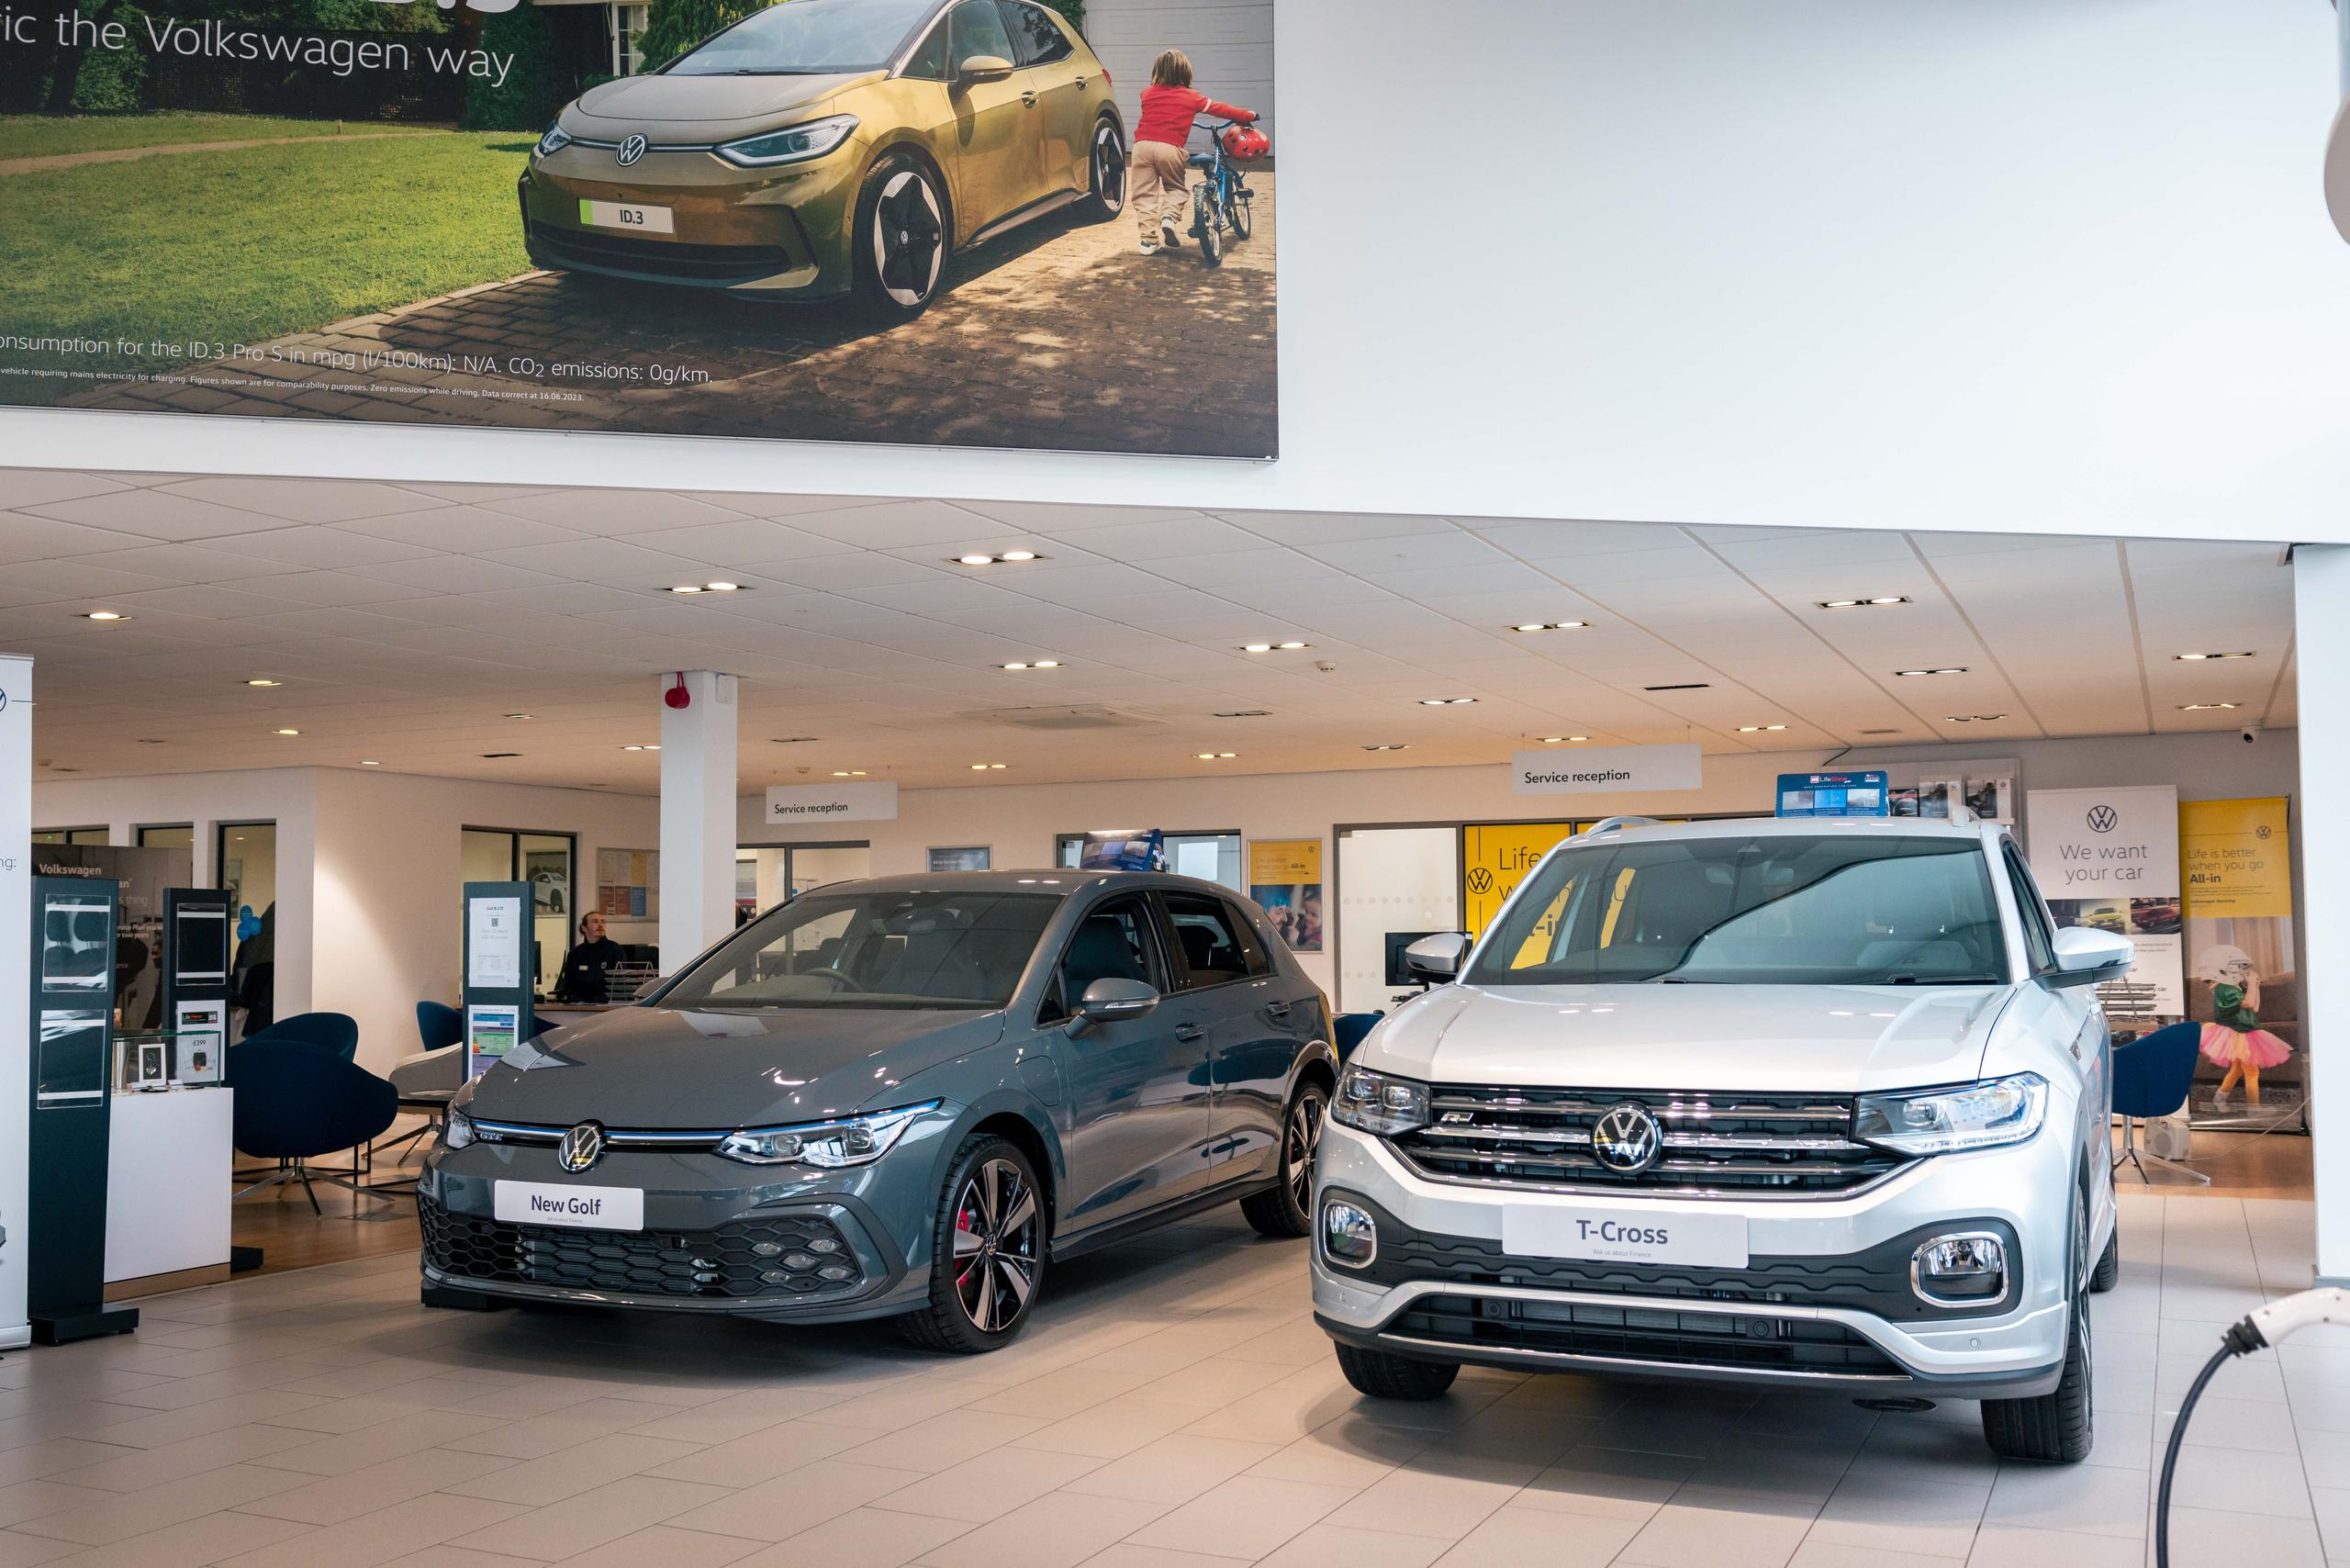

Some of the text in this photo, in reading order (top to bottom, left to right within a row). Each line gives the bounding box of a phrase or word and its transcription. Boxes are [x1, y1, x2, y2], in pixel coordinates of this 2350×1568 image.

[0, 6, 515, 88] ic the Volkswagen way
[620, 209, 643, 225] ID.3
[118, 338, 143, 356] for
[151, 340, 182, 357] the
[189, 342, 225, 359] ID.3
[233, 343, 264, 362] Pro
[272, 345, 283, 363] S
[290, 347, 305, 364] in
[313, 351, 356, 369] mpg
[464, 355, 502, 374] N/A.
[551, 361, 643, 380] emissions:
[650, 364, 713, 385] 0g/km.
[1, 367, 29, 375] vehicle
[31, 368, 68, 379] requiring
[95, 372, 136, 381] electricity
[151, 375, 188, 384] charging.
[190, 375, 219, 386] Figures
[221, 377, 247, 386] shown
[276, 380, 330, 391] comparability
[331, 383, 368, 392] purposes.
[370, 384, 388, 392] Zero
[389, 385, 428, 394] emissions
[429, 386, 450, 395] while
[452, 387, 480, 398] driving.
[482, 389, 499, 398] Data
[501, 391, 528, 399] correct
[540, 392, 585, 401] 16.06.2023.
[1525, 769, 1630, 783] Service reception
[775, 802, 848, 814] Service reception
[1499, 846, 1542, 870] Life
[2059, 845, 2148, 859] We want
[2188, 847, 2256, 858] Life is better
[39, 864, 102, 877] Volkswagen
[2188, 861, 2264, 872] when you go
[2065, 868, 2144, 885] your car
[2190, 874, 2221, 883] All-in
[126, 895, 148, 907] thing
[532, 1195, 601, 1215] New Golf
[1576, 1219, 1669, 1245] T-Cross
